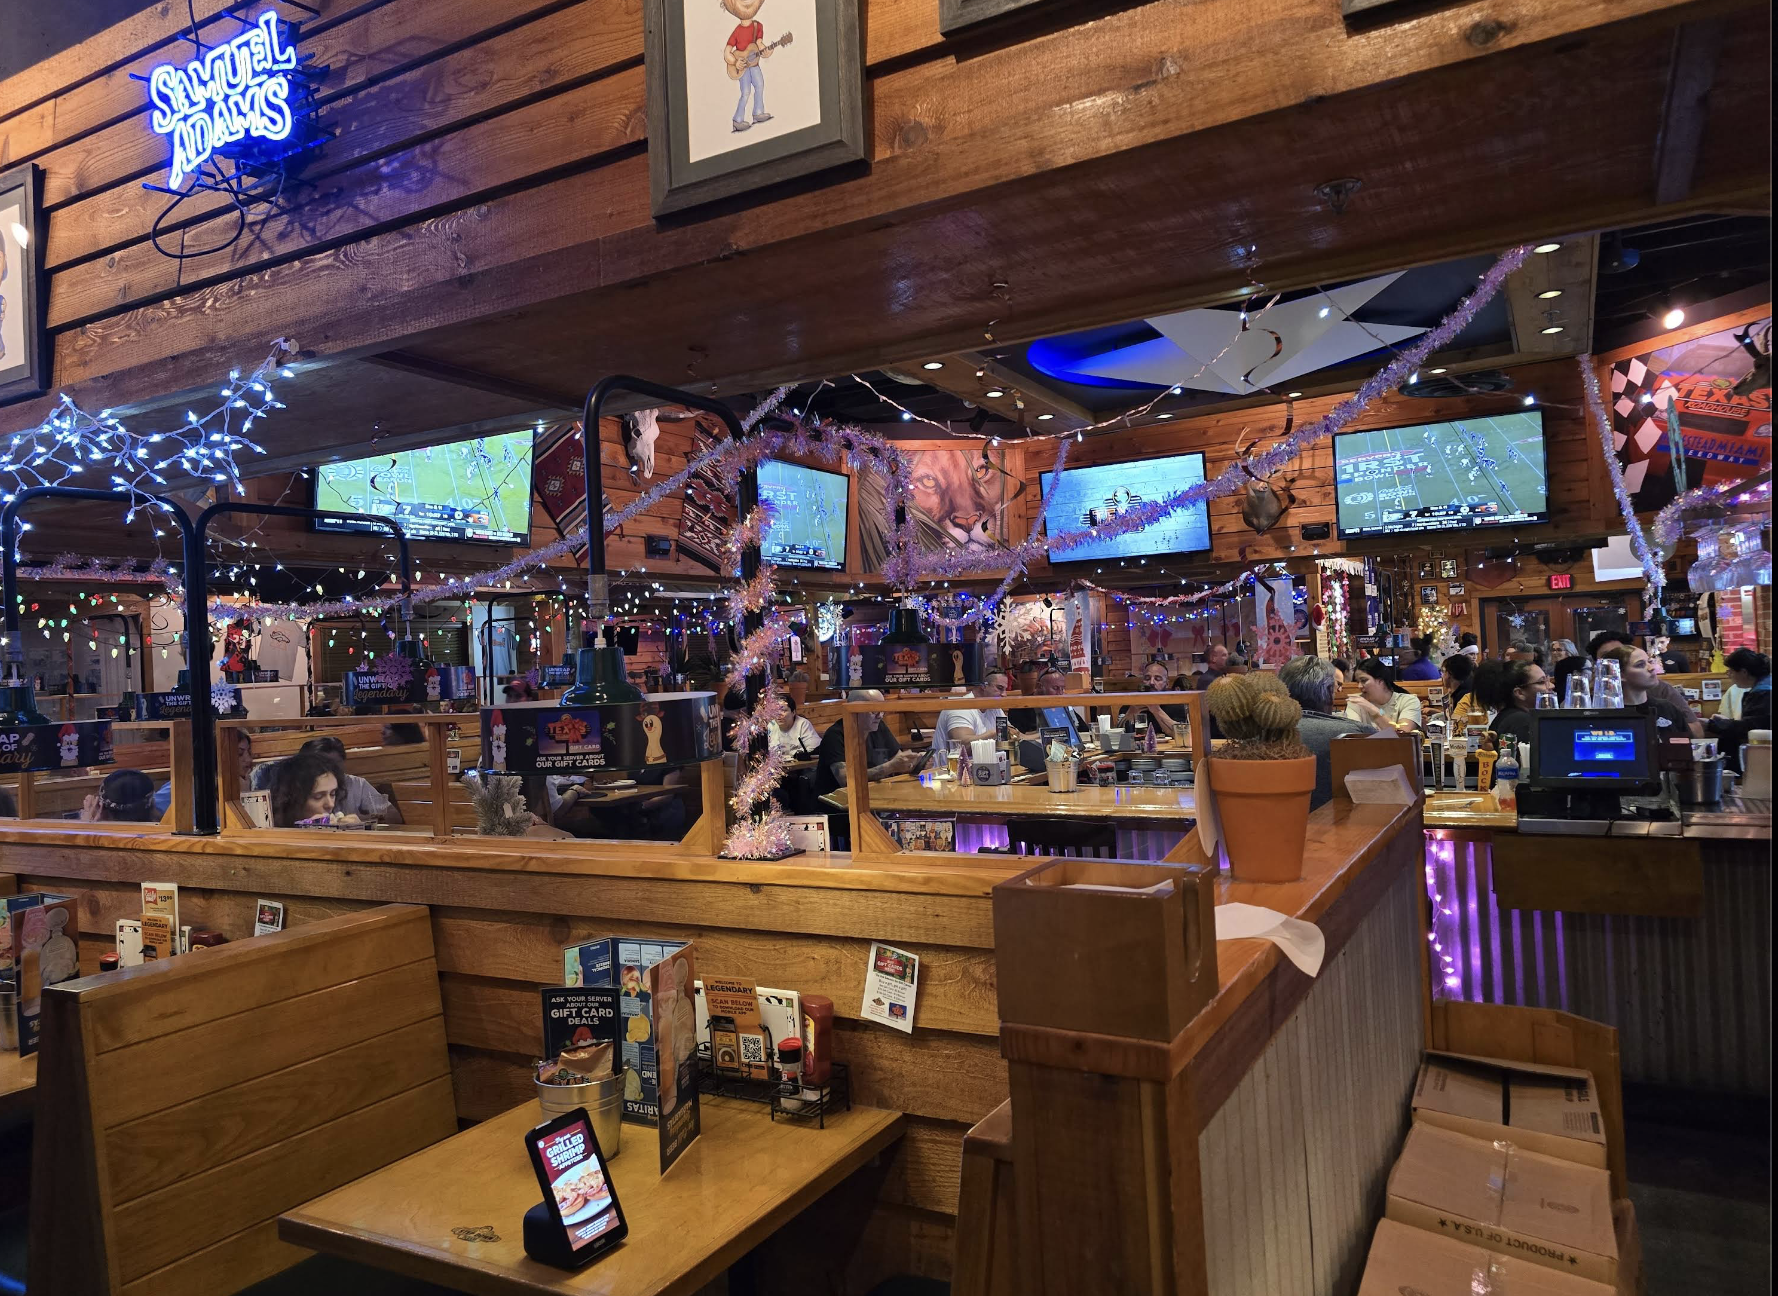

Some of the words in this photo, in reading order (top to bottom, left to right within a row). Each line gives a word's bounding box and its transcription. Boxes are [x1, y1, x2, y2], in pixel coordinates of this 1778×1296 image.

[151, 10, 296, 133] SAMUEL
[169, 77, 292, 190] ADAMS
[1685, 401, 1750, 416] ROADHOUSE
[1688, 449, 1745, 464] EEDWAY
[1551, 575, 1570, 589] EXIT
[576, 758, 606, 767] CARDS
[142, 921, 168, 929] LEGENDARY
[705, 984, 753, 995] LEGENDARY
[730, 999, 753, 1007] BELOW
[551, 1008, 577, 1018] GIFT
[581, 1008, 614, 1018] CARD
[568, 1017, 600, 1025] DEALS
[627, 1102, 659, 1117] ARITAS
[546, 1134, 585, 1158] GRILLED
[550, 1143, 586, 1168] SHRIMP
[1451, 1221, 1484, 1238] U.S.A.
[1486, 1233, 1503, 1244] OF
[1505, 1237, 1565, 1261] PRODUCT
